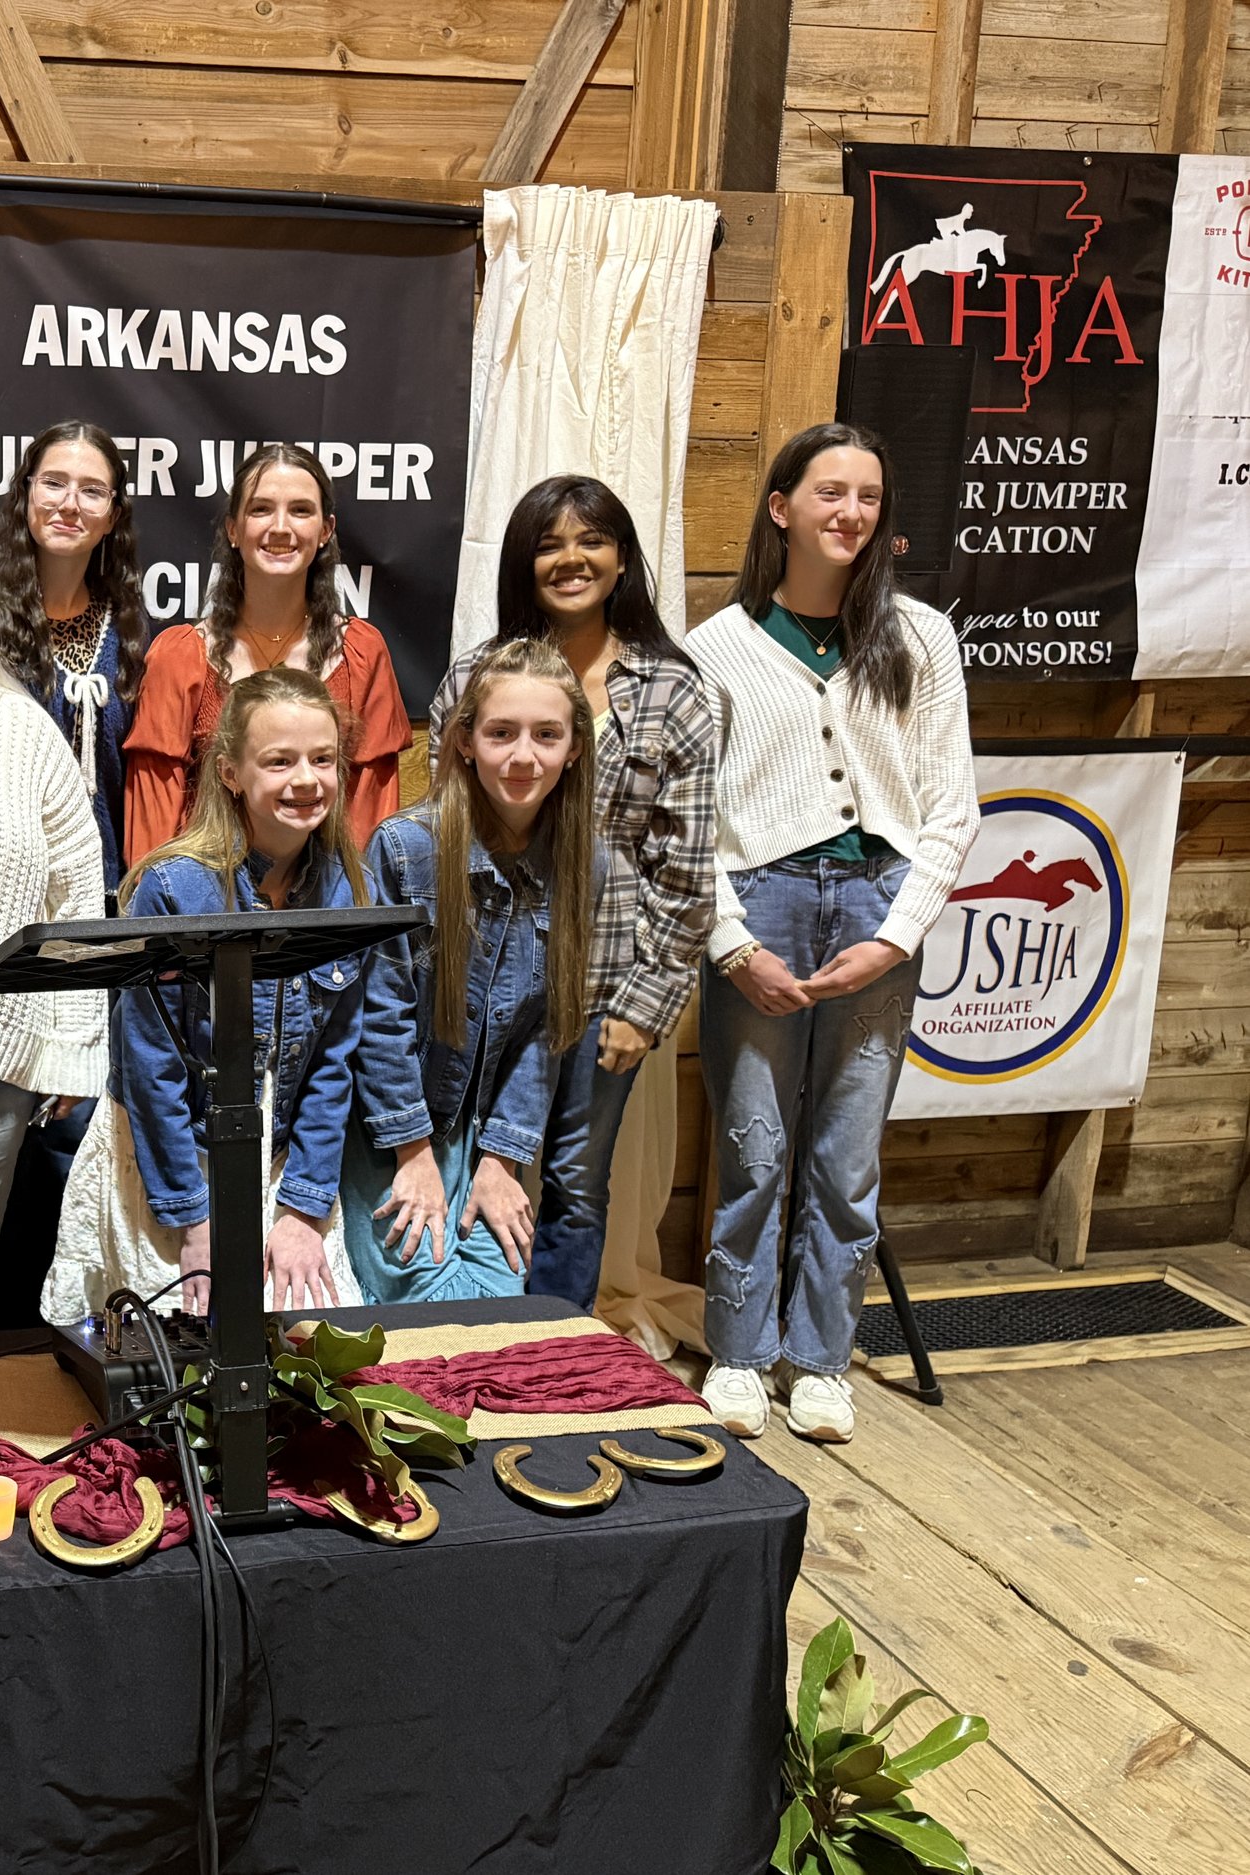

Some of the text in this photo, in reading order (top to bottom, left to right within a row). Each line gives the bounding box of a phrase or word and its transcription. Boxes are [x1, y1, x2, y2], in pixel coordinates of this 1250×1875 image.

[1216, 179, 1250, 203] PO
[21, 303, 348, 376] ARKANSAS
[863, 268, 1144, 386] AHJA
[965, 436, 1089, 466] ANSAS
[194, 439, 434, 501] JUPER
[992, 481, 1128, 517] JUMPER
[955, 525, 1098, 555] CATION
[957, 611, 1018, 643] you
[1022, 606, 1049, 629] to
[1055, 609, 1101, 629] our
[961, 641, 1113, 667] PONSORS!
[950, 1000, 1033, 1017] AFFILIATE
[922, 1016, 1057, 1035] ORGANIZATION
